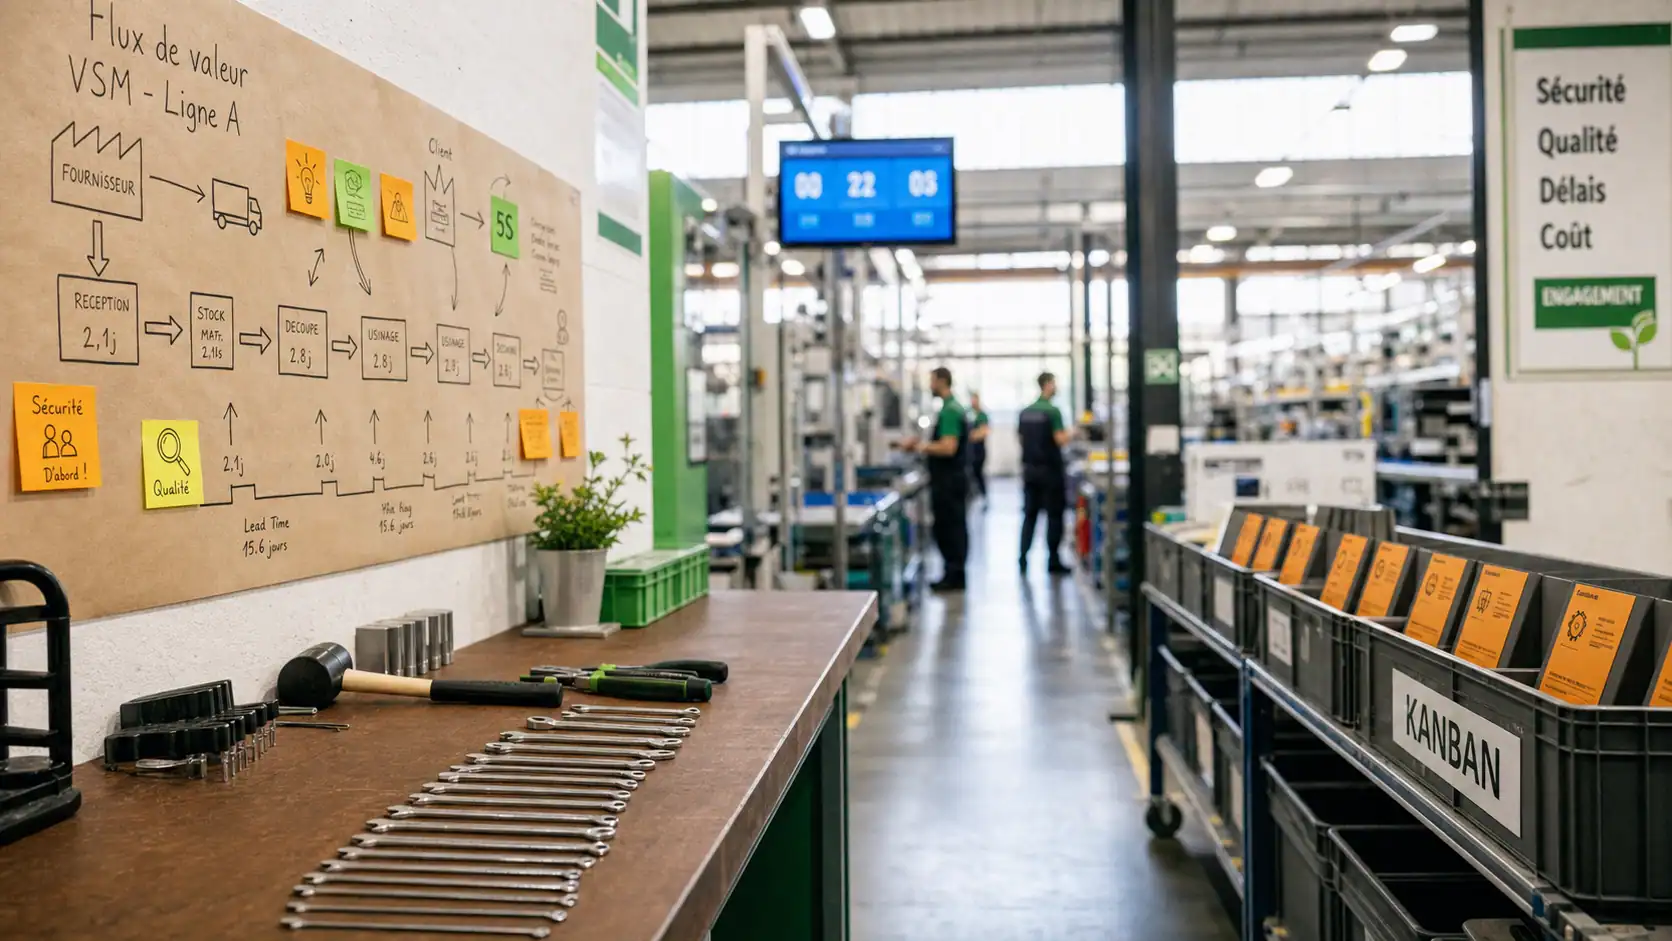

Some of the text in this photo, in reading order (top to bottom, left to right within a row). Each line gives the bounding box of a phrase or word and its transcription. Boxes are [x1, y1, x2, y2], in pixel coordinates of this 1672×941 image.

[90, 0, 248, 87] Flux de valeur
[68, 54, 131, 105] VSM
[165, 80, 217, 133] Ligne
[226, 101, 241, 136] A
[1536, 74, 1626, 105] Sécurité
[428, 137, 453, 161] Client
[1538, 124, 1618, 159] Qualité
[847, 170, 876, 198] 22
[1540, 174, 1607, 205] Délais
[496, 210, 514, 240] 5S
[1540, 221, 1593, 250] Coût
[1541, 284, 1643, 307] ENGAGEMENT
[197, 306, 225, 321] STOCK
[285, 319, 319, 336] DECOUPE
[368, 328, 400, 343] USINAGE
[32, 394, 84, 416] Sécurité
[43, 466, 79, 483] D'abord
[153, 479, 190, 498] Qualité
[244, 515, 290, 533] Lead Time
[242, 538, 288, 559] 15.6 jours
[1406, 694, 1500, 801] KANBAN
